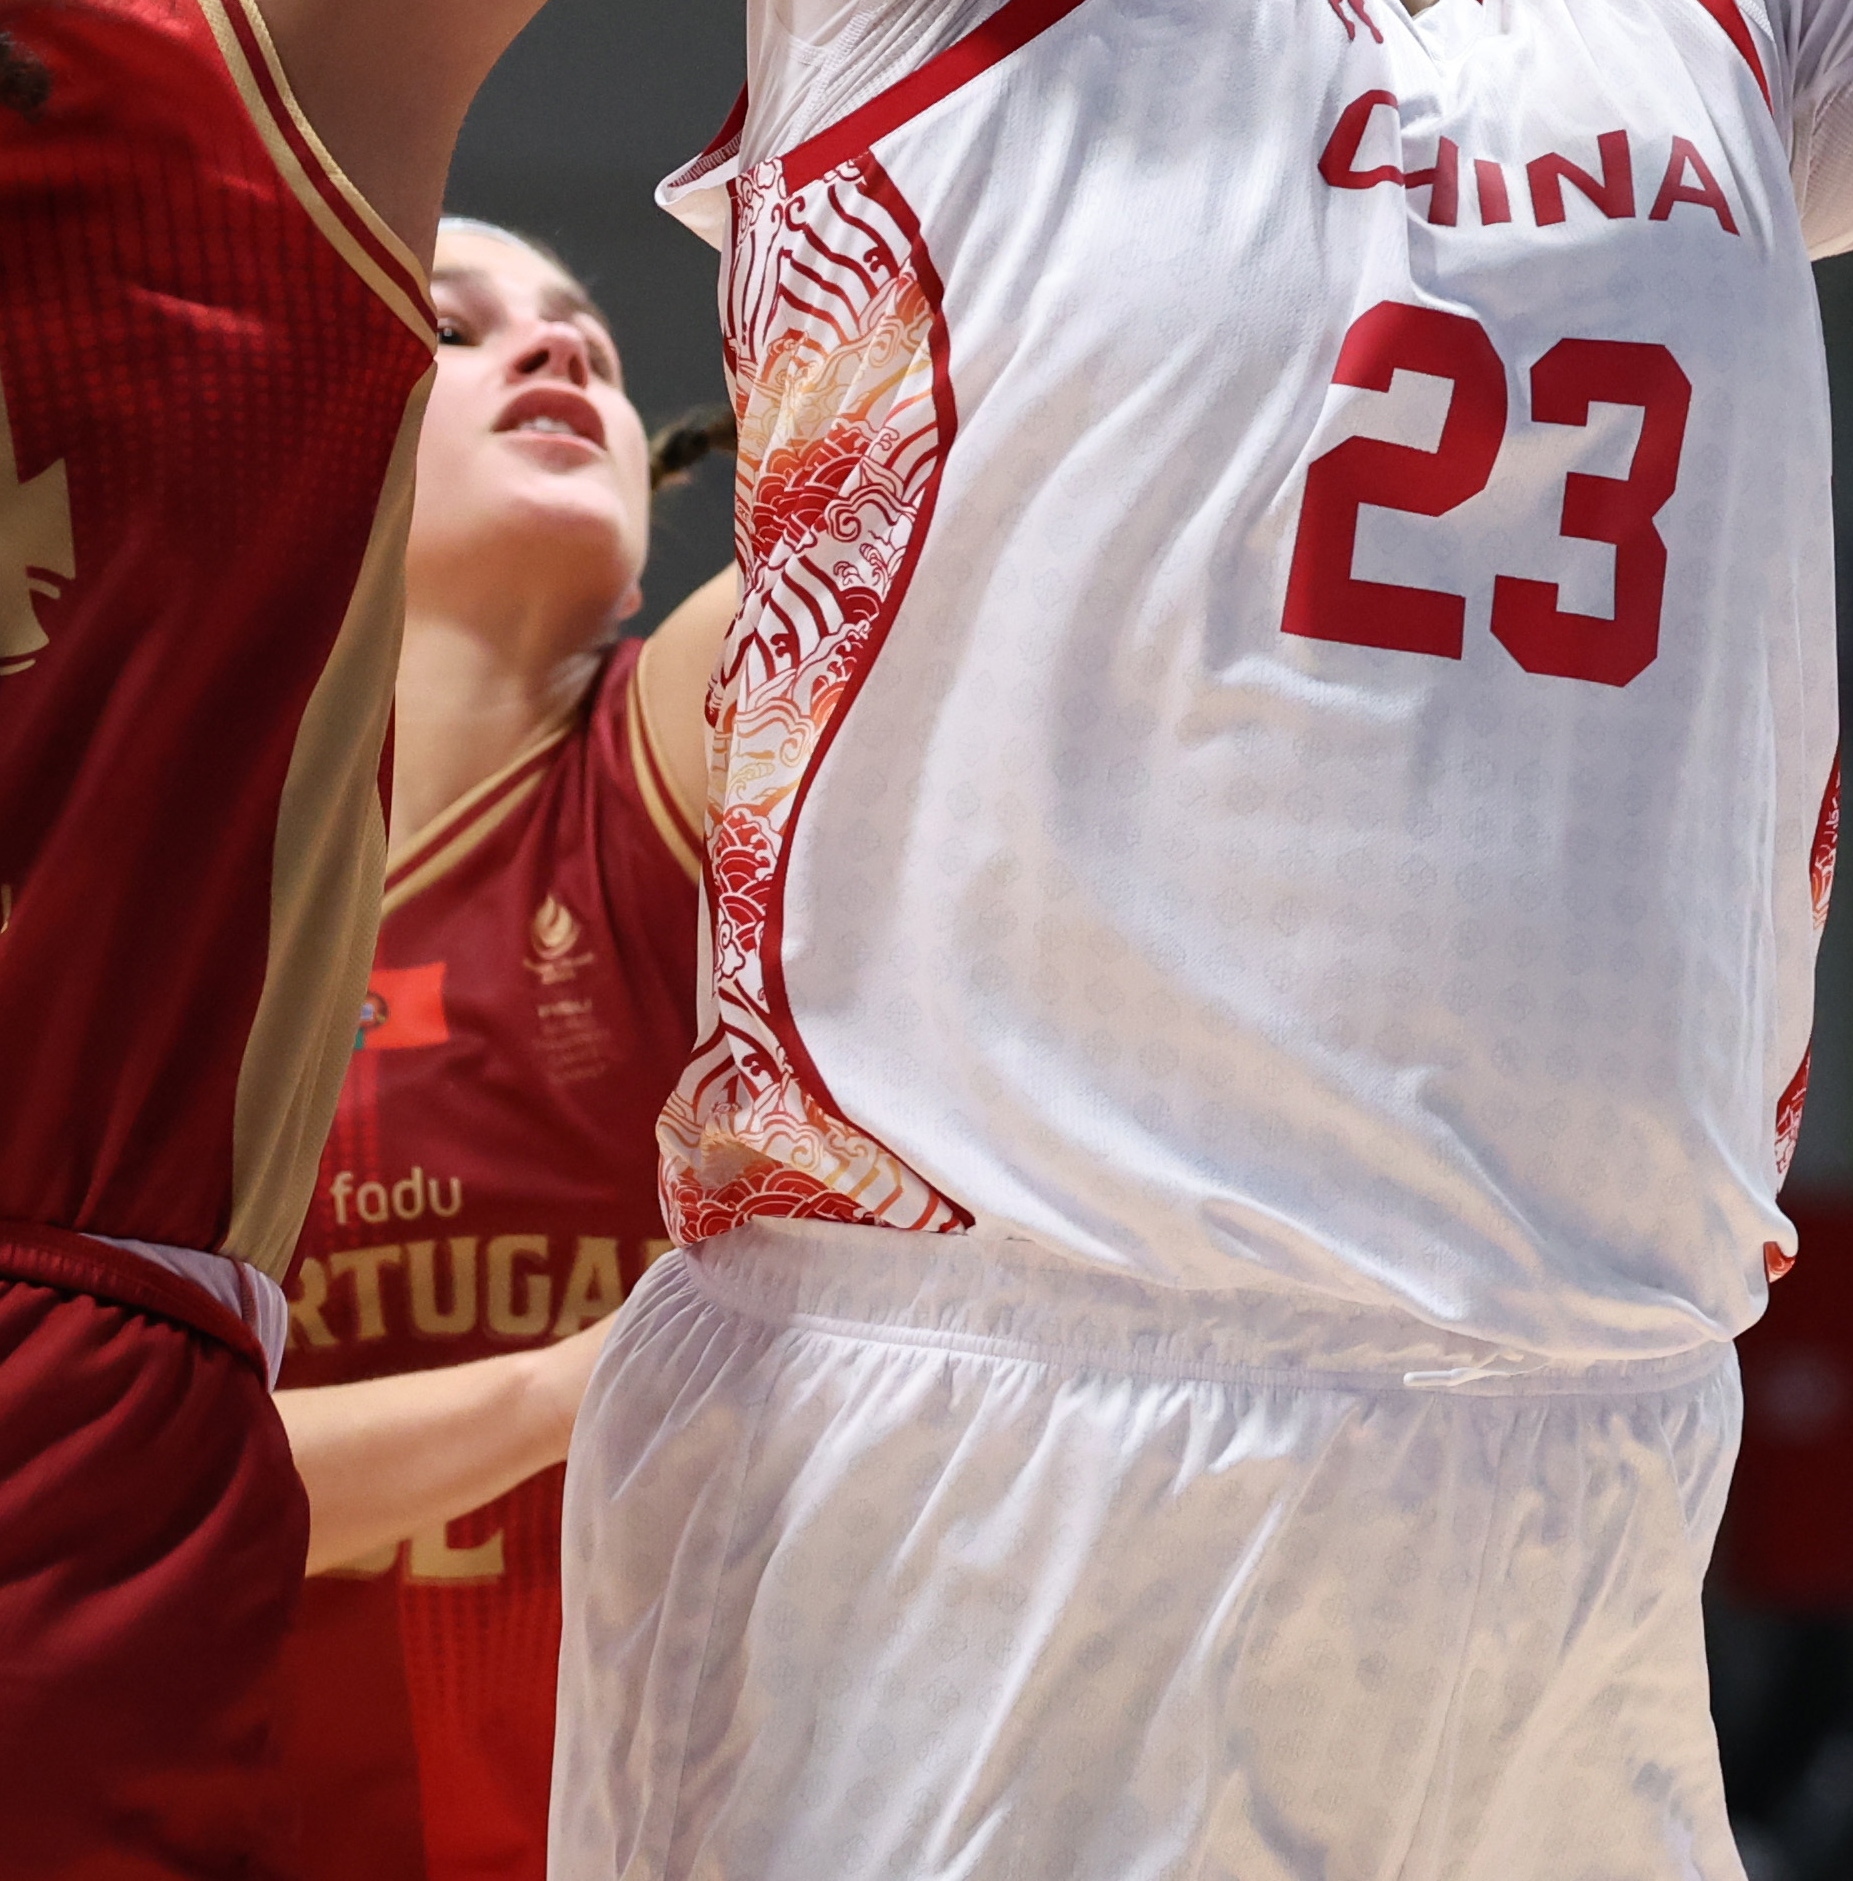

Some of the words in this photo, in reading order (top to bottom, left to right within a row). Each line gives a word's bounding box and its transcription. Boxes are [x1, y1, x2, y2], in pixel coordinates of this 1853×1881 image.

[1320, 90, 1740, 235] CHINA
[1282, 300, 1692, 687] 23
[330, 1166, 462, 1225] fadu
[287, 1234, 674, 1349] RTUGA
